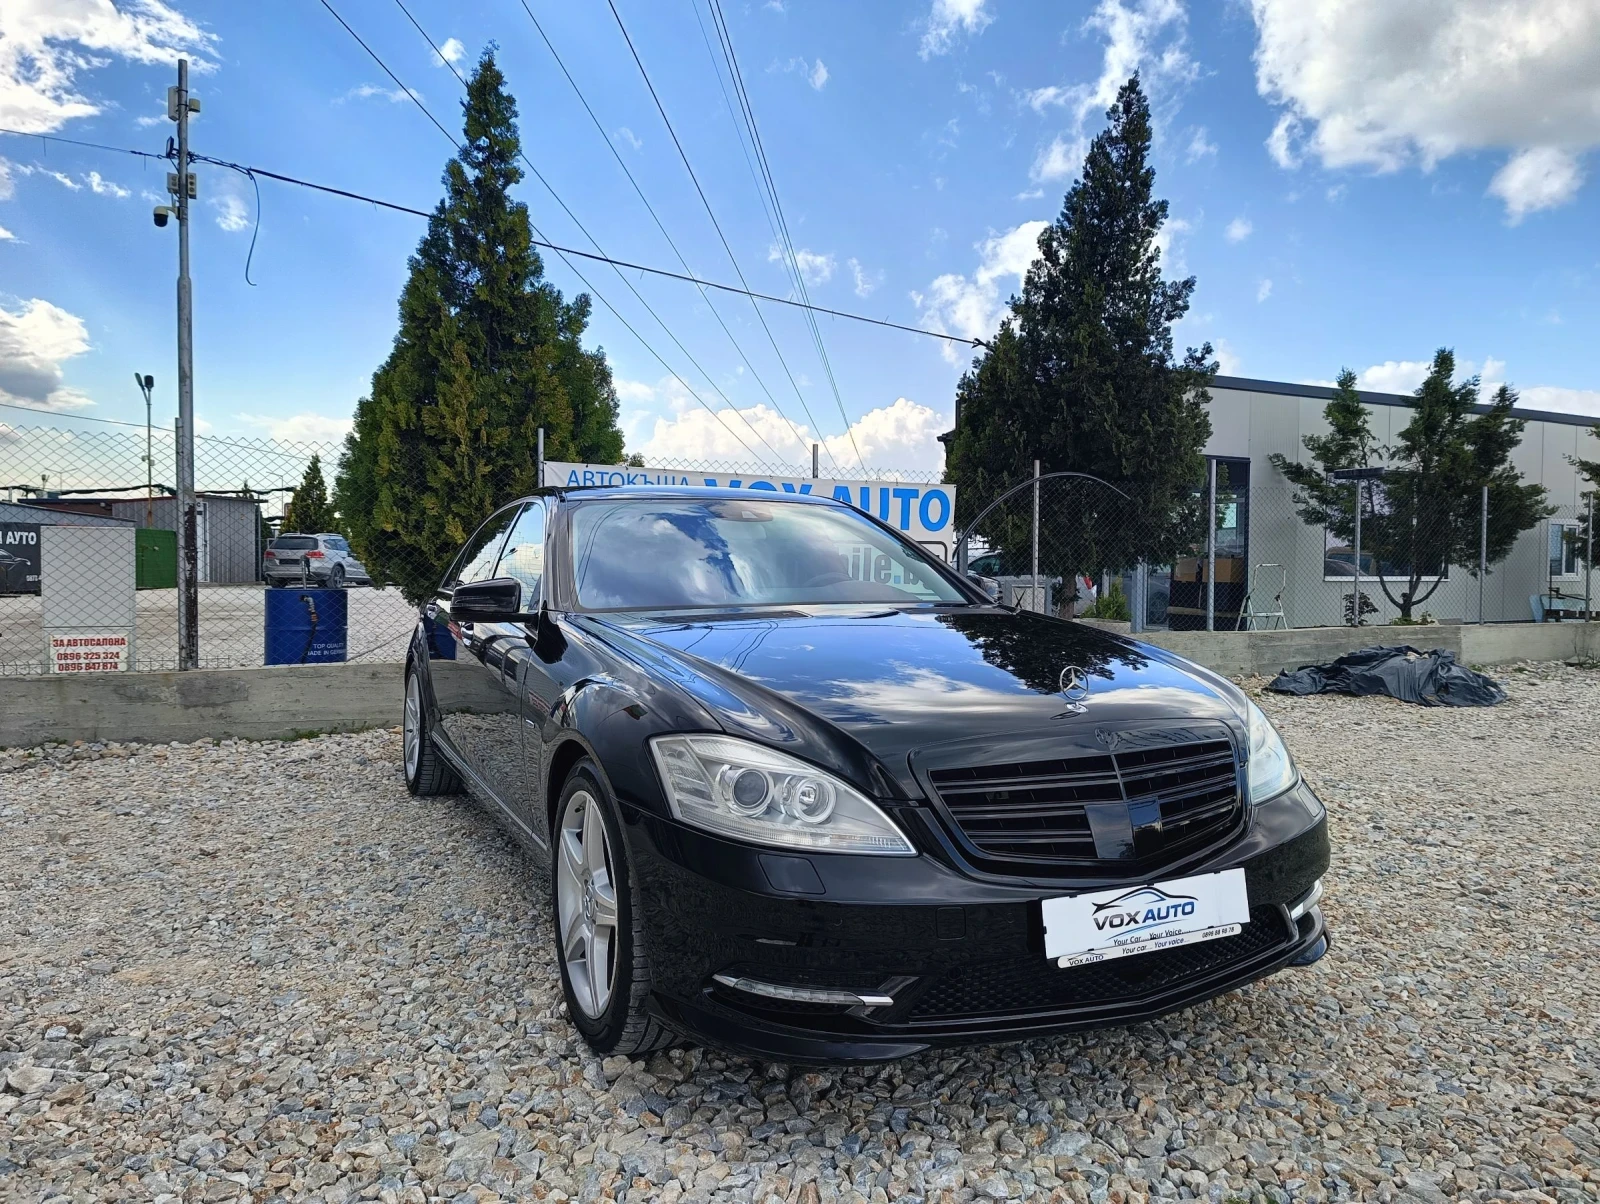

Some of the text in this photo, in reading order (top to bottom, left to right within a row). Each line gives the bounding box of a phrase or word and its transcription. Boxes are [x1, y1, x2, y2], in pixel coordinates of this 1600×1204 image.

[5, 531, 37, 545] АУТО
[53, 637, 126, 648] ЗА АВТОСАЛОНА
[57, 651, 120, 661] 0896 325 324
[58, 663, 83, 671] 0896
[1093, 901, 1195, 931] VOX AUTO
[1113, 937, 1128, 947] Your
[1122, 947, 1136, 955] Your
[1154, 940, 1168, 949] Your
[1068, 954, 1104, 966] VOX AUTO
